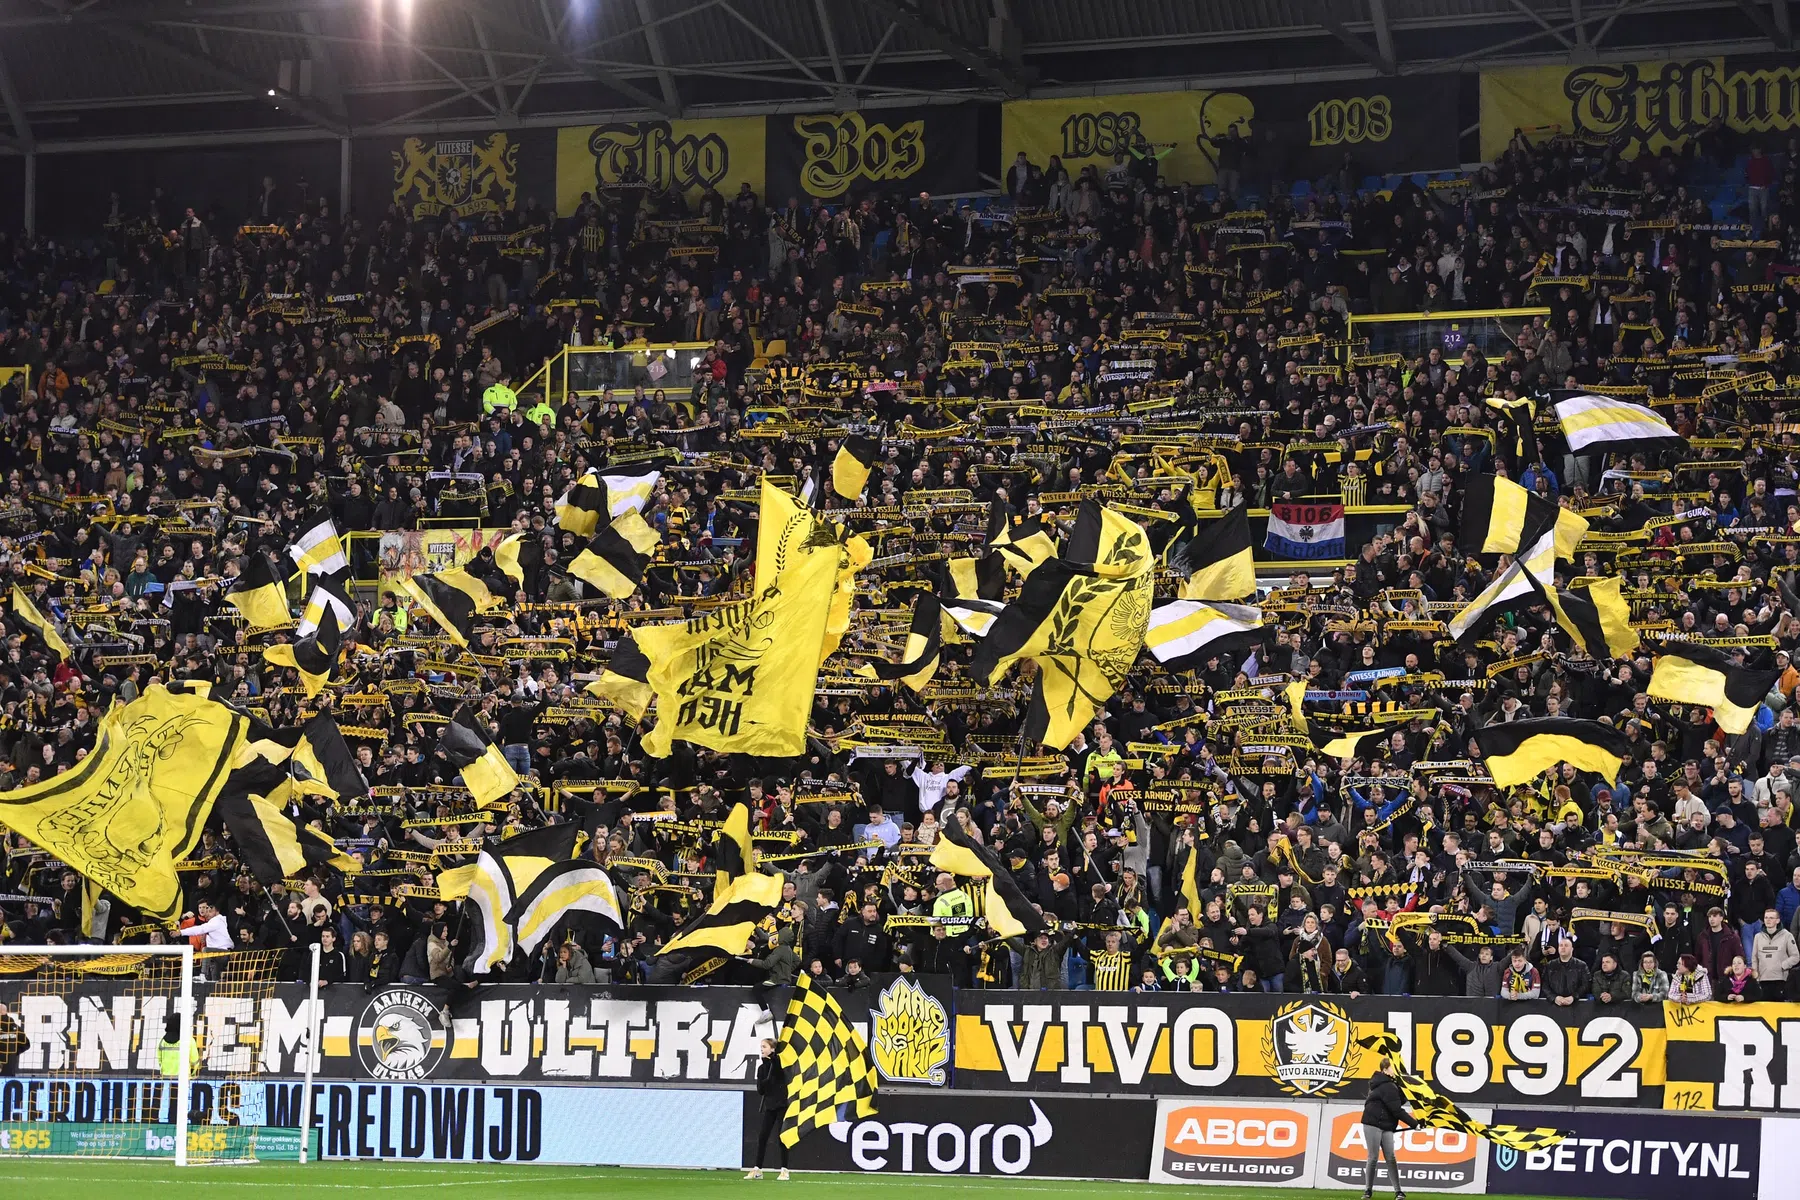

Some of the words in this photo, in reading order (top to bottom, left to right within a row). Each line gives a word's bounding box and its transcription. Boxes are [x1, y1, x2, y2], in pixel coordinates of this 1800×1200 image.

[1308, 95, 1391, 147] 1998
[436, 141, 473, 154] VITESSE
[797, 112, 925, 197] Bos
[590, 124, 727, 197] Theo
[1444, 334, 1461, 343] 212
[1675, 371, 1706, 380] VITESSE
[1737, 372, 1769, 385] ARNHEM
[1027, 444, 1045, 453] BOS
[1047, 444, 1070, 455] THEO
[1041, 493, 1063, 501] MISTER
[914, 533, 941, 541] VITESSE
[430, 544, 454, 553] VITESSE
[1389, 590, 1419, 599] ARNHEM
[1742, 636, 1770, 644] MORE
[1488, 659, 1512, 672] VITESSE
[1250, 675, 1284, 685] VITESSE
[1350, 672, 1376, 681] VITESSE
[1443, 679, 1474, 687] VITESSE
[1153, 685, 1181, 694] THEO
[1184, 684, 1205, 694] BOS
[1228, 689, 1259, 698] VITESSE
[1231, 706, 1275, 714] VITESSE
[856, 713, 890, 722] VITESSE
[891, 713, 925, 723] ARNHEM
[1285, 736, 1309, 745] MORE
[1242, 745, 1287, 754] VITESSE
[1228, 766, 1259, 775] VITESSE
[1261, 766, 1293, 775] ARNHEM
[1346, 776, 1406, 786] VITESSE
[1020, 786, 1066, 794] VITESSE
[411, 792, 468, 802] VITESSE
[1111, 789, 1142, 801] VITESSE
[1144, 791, 1175, 802] ARNHEM
[1143, 801, 1173, 812] VITESSE
[409, 817, 436, 825] READY
[439, 815, 458, 823] FOR
[459, 813, 485, 821] MORE
[765, 831, 793, 839] MORE
[437, 844, 469, 853] VITESSE
[1596, 856, 1623, 870] VITESSE
[1234, 884, 1270, 894] VITESSE
[1651, 877, 1686, 891] VITESSE
[1687, 881, 1726, 898] ARNHEM
[890, 916, 926, 924] VITESSE
[1437, 913, 1462, 922] VITESSE
[373, 989, 433, 1015] ARNHEM
[1669, 1006, 1705, 1028] VAK
[18, 996, 325, 1074] RNHEM
[984, 1004, 1234, 1087] VIVO
[1388, 1011, 1640, 1098] 1892
[1279, 1068, 1301, 1077] VIVO
[1302, 1067, 1341, 1079] ARNHEM
[1673, 1090, 1706, 1111] 112
[1174, 1117, 1299, 1148] ABCO
[1525, 1138, 1750, 1179] BETCITY.NL
[1171, 1160, 1295, 1177] BEVEILIGING
